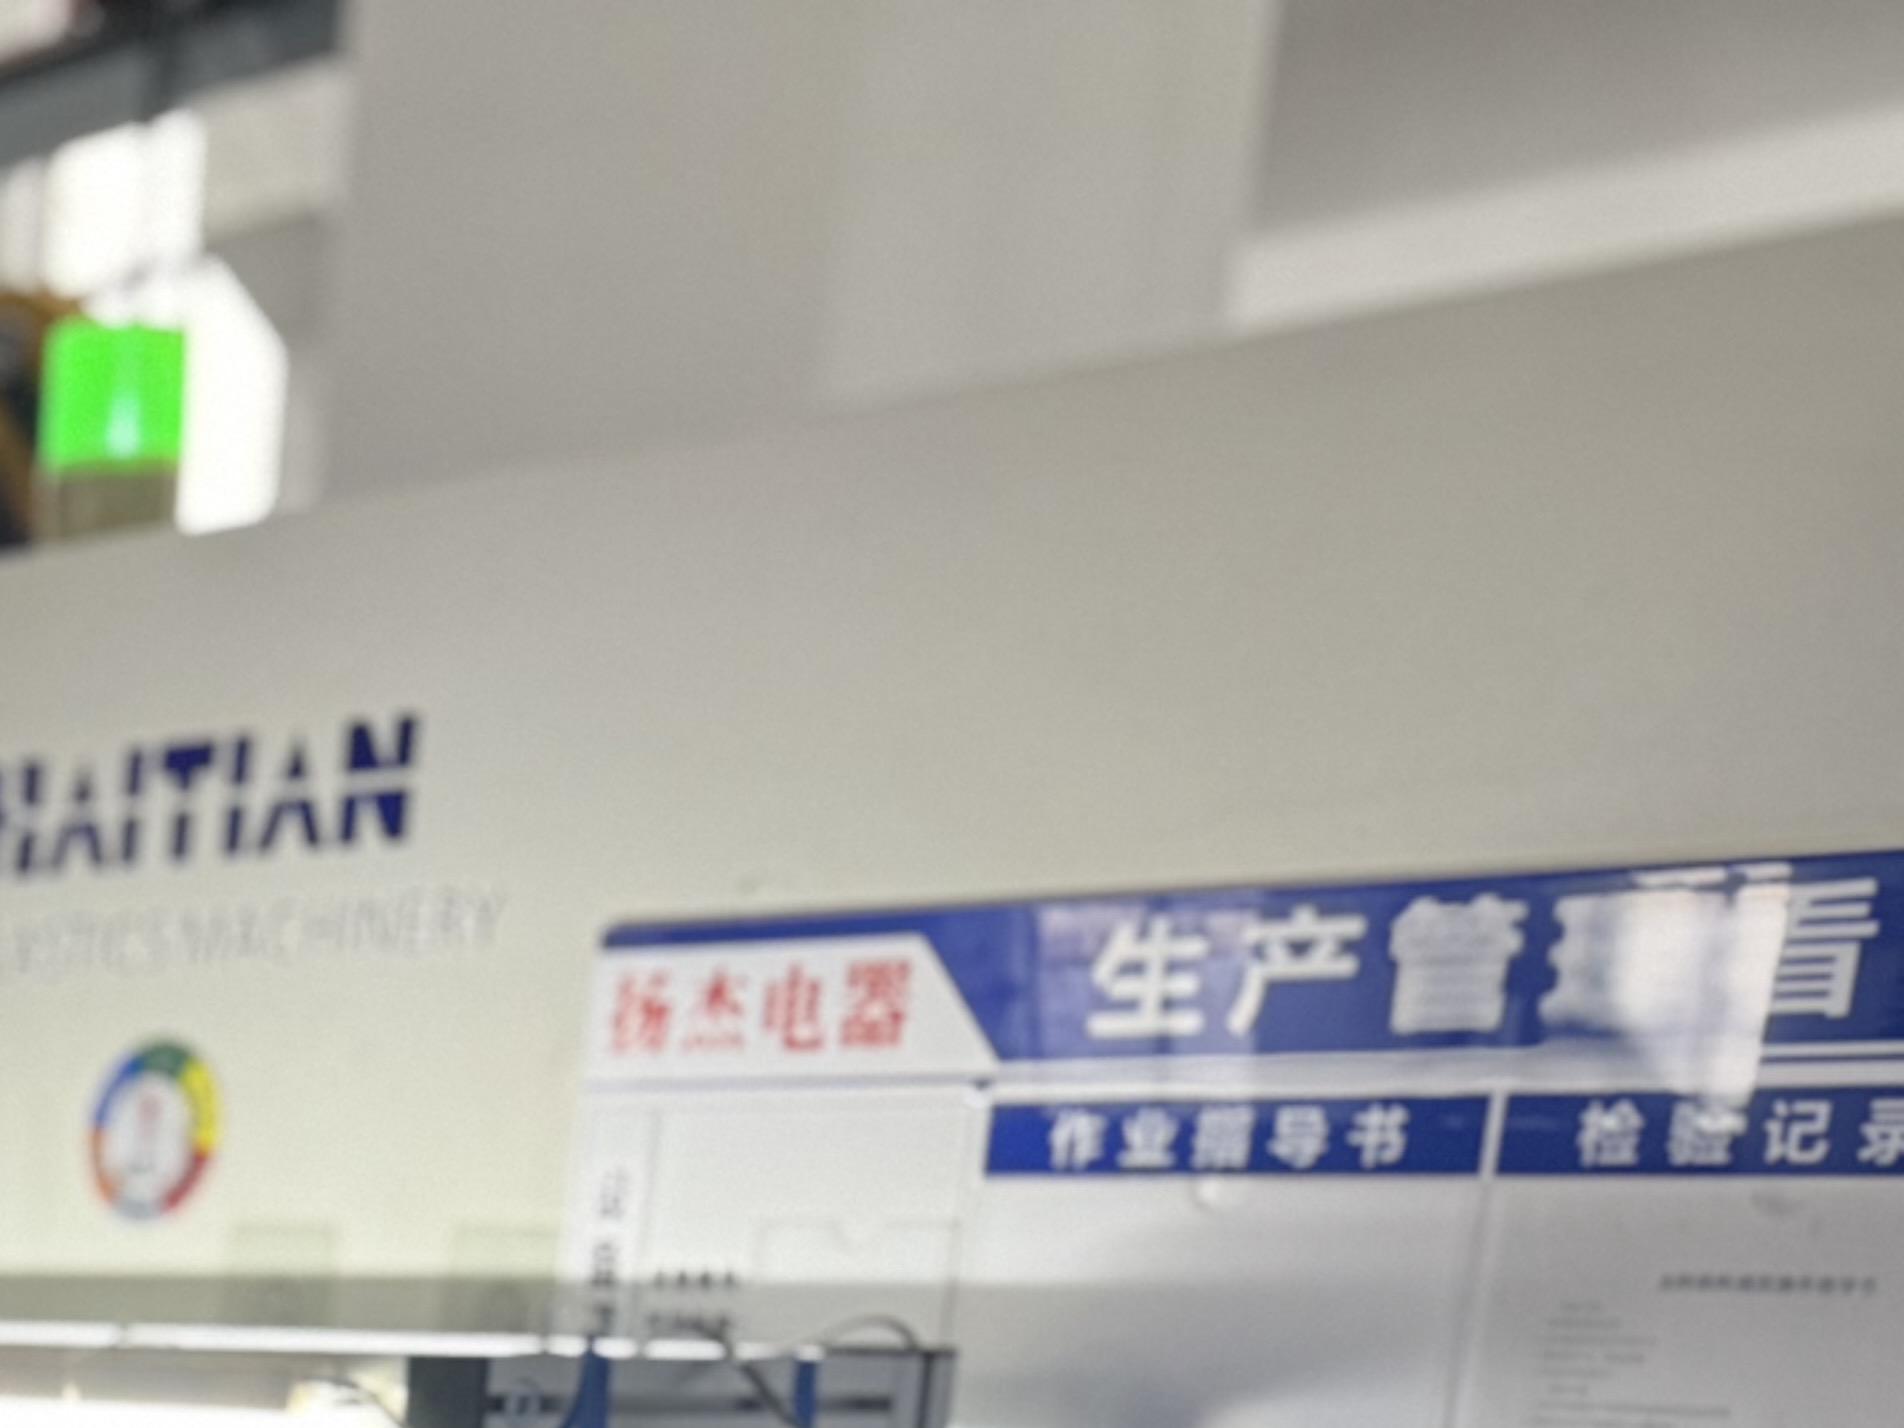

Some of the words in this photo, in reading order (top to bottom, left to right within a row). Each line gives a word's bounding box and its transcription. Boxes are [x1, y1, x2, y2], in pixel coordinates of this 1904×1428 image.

[609, 957, 912, 1054] 扬杰电器
[1048, 1102, 1411, 1171] 作业指导书
